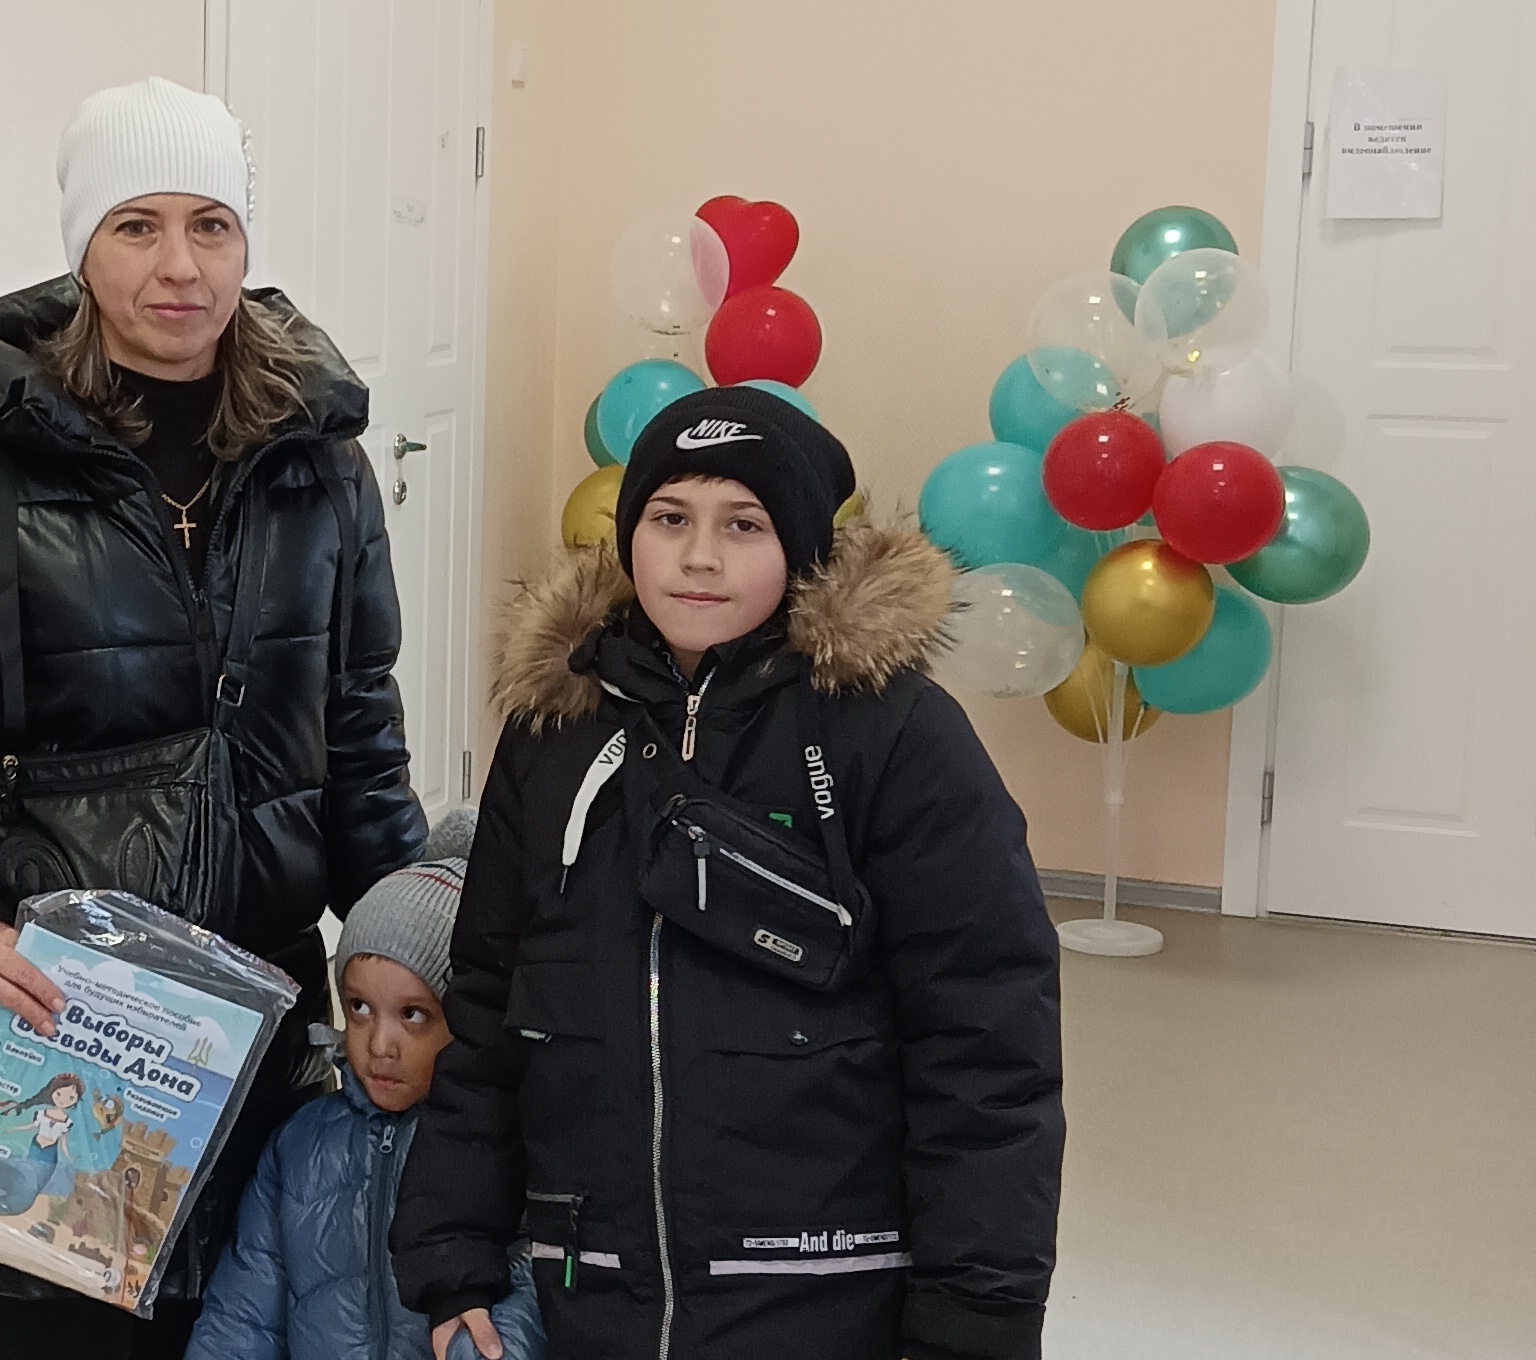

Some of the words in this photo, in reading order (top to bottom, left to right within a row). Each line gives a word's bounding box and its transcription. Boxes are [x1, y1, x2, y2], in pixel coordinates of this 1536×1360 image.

[690, 419, 747, 438] NIKE
[804, 745, 835, 820] vogue
[17, 1015, 122, 1067] Веводы
[123, 1057, 195, 1096] Дона
[65, 1005, 166, 1058] Выборы
[799, 1231, 828, 1253] And
[832, 1229, 855, 1251] die
